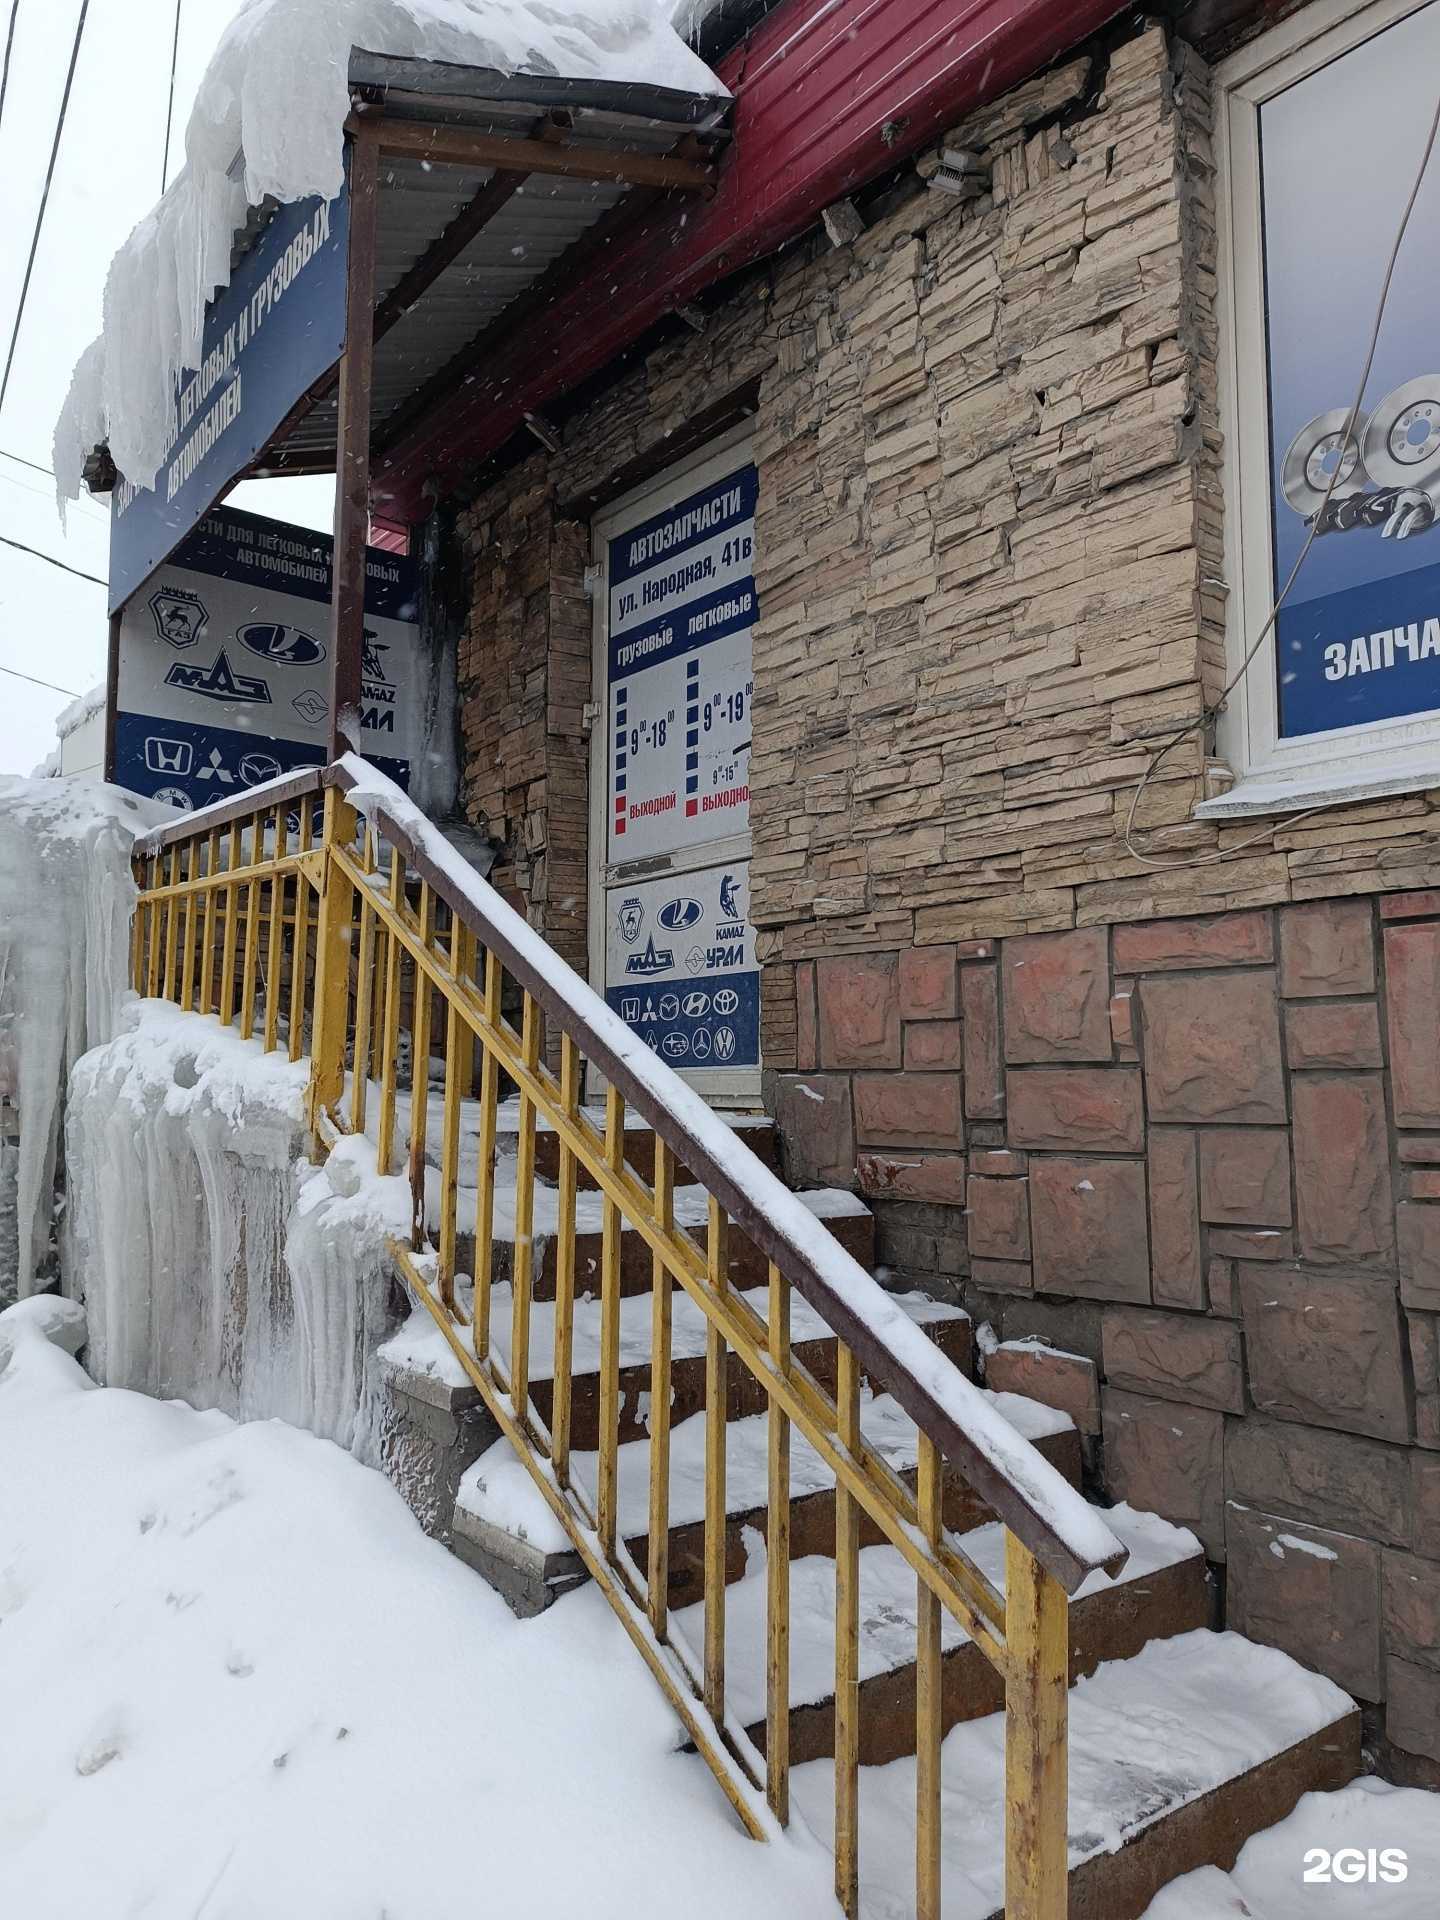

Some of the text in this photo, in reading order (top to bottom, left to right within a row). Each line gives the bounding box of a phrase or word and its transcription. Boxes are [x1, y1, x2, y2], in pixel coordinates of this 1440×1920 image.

[239, 305, 248, 352] И
[251, 199, 330, 336] ГРУЗОВЫХ
[167, 365, 241, 504] АВТОМОБИЛЕЙ
[226, 524, 254, 544] ДЛЯ
[629, 486, 741, 567] АВТОЗАПЧАСТИ
[236, 548, 328, 584] АВТОМОБИЛЕЙ
[618, 593, 638, 621] ул.
[642, 555, 716, 606] Народная,
[687, 593, 752, 635] легковые
[617, 626, 674, 667] грузовые
[361, 686, 396, 703] AMAZ
[629, 790, 677, 819] ВЫХОДНОЙ
[702, 785, 751, 812] ВЫХОДНО
[715, 925, 745, 941] KAMAZ
